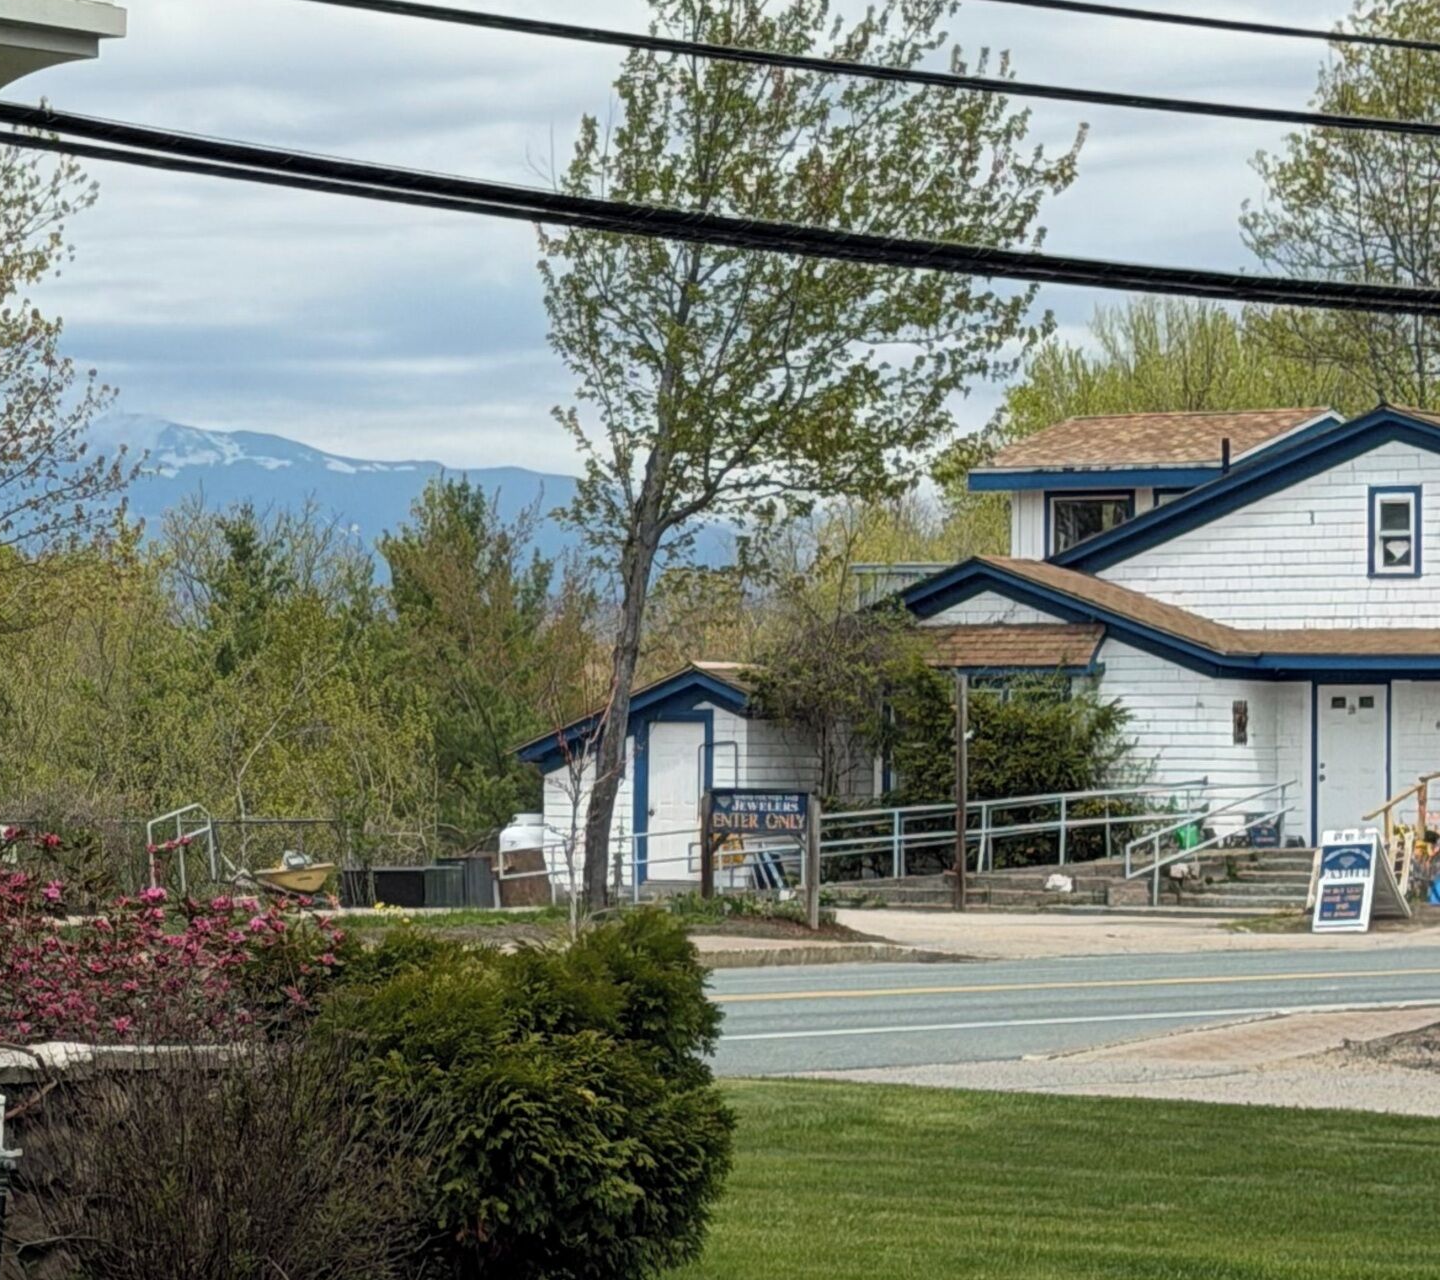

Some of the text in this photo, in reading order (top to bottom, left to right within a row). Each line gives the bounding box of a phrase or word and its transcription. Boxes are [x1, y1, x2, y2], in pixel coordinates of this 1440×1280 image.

[731, 799, 799, 812] JEWELERS
[712, 813, 806, 829] ENTER ONLY
